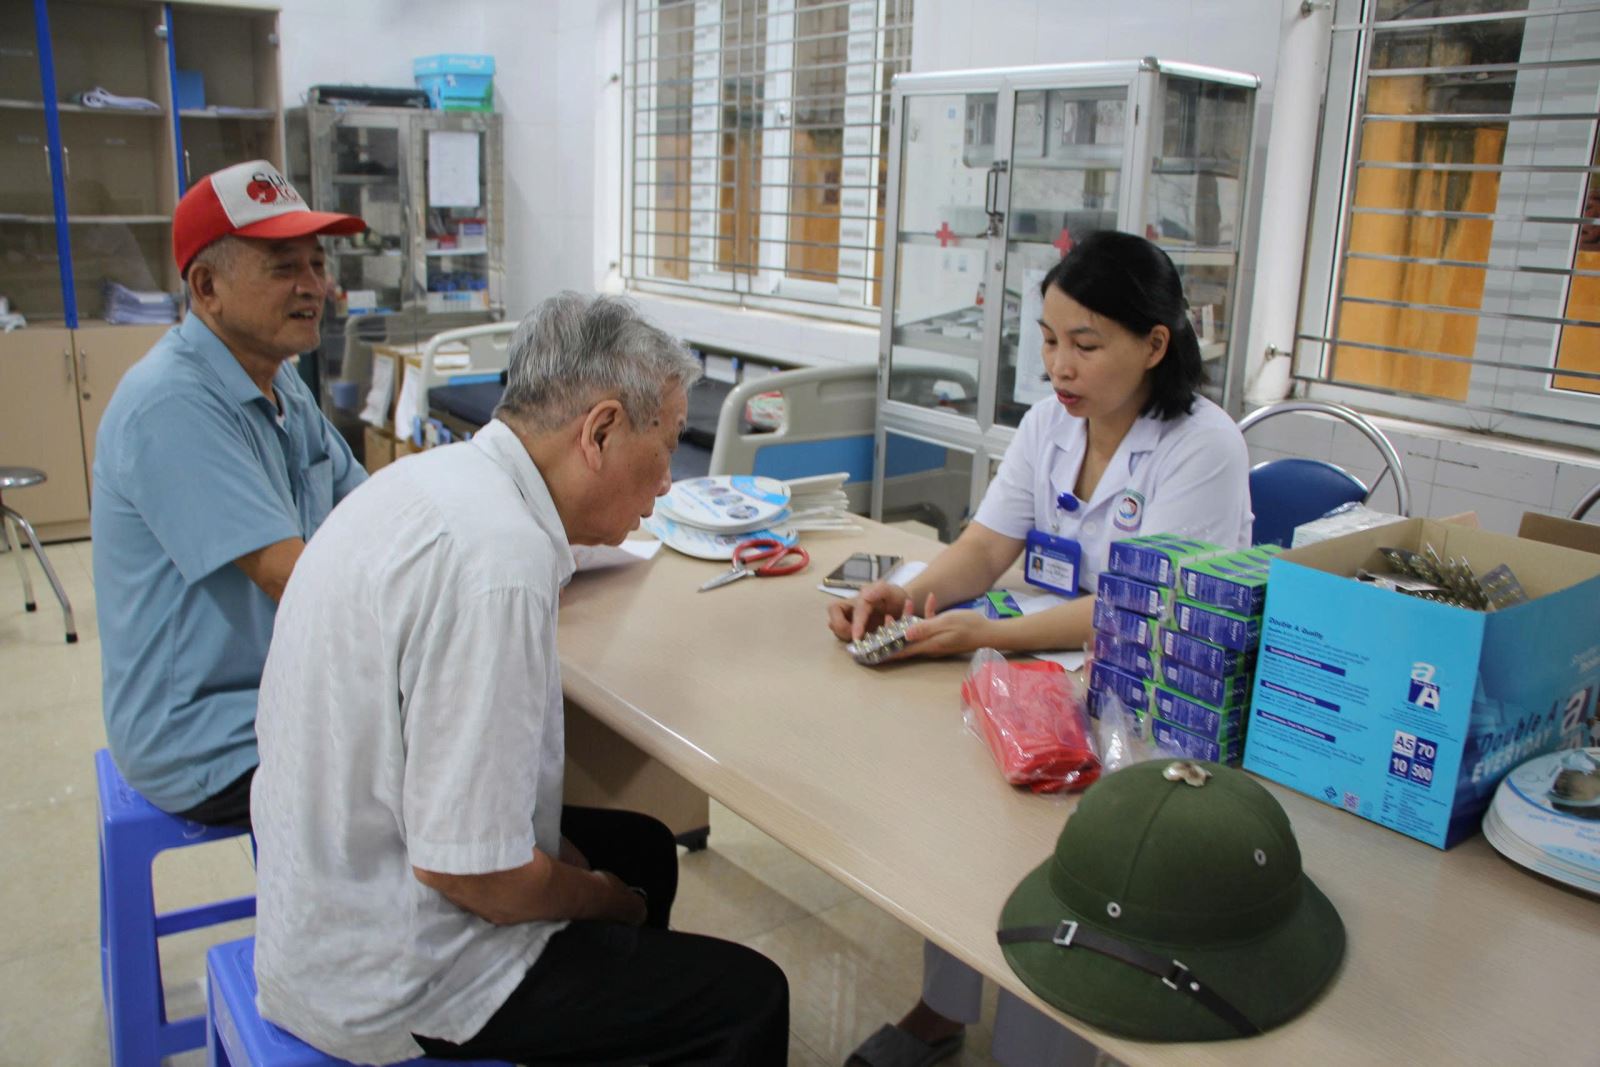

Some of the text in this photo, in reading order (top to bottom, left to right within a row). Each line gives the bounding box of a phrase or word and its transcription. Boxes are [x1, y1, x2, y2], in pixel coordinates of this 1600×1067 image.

[1396, 735, 1414, 751] A5
[1417, 742, 1436, 759] 70
[1392, 757, 1433, 781] 10 500
